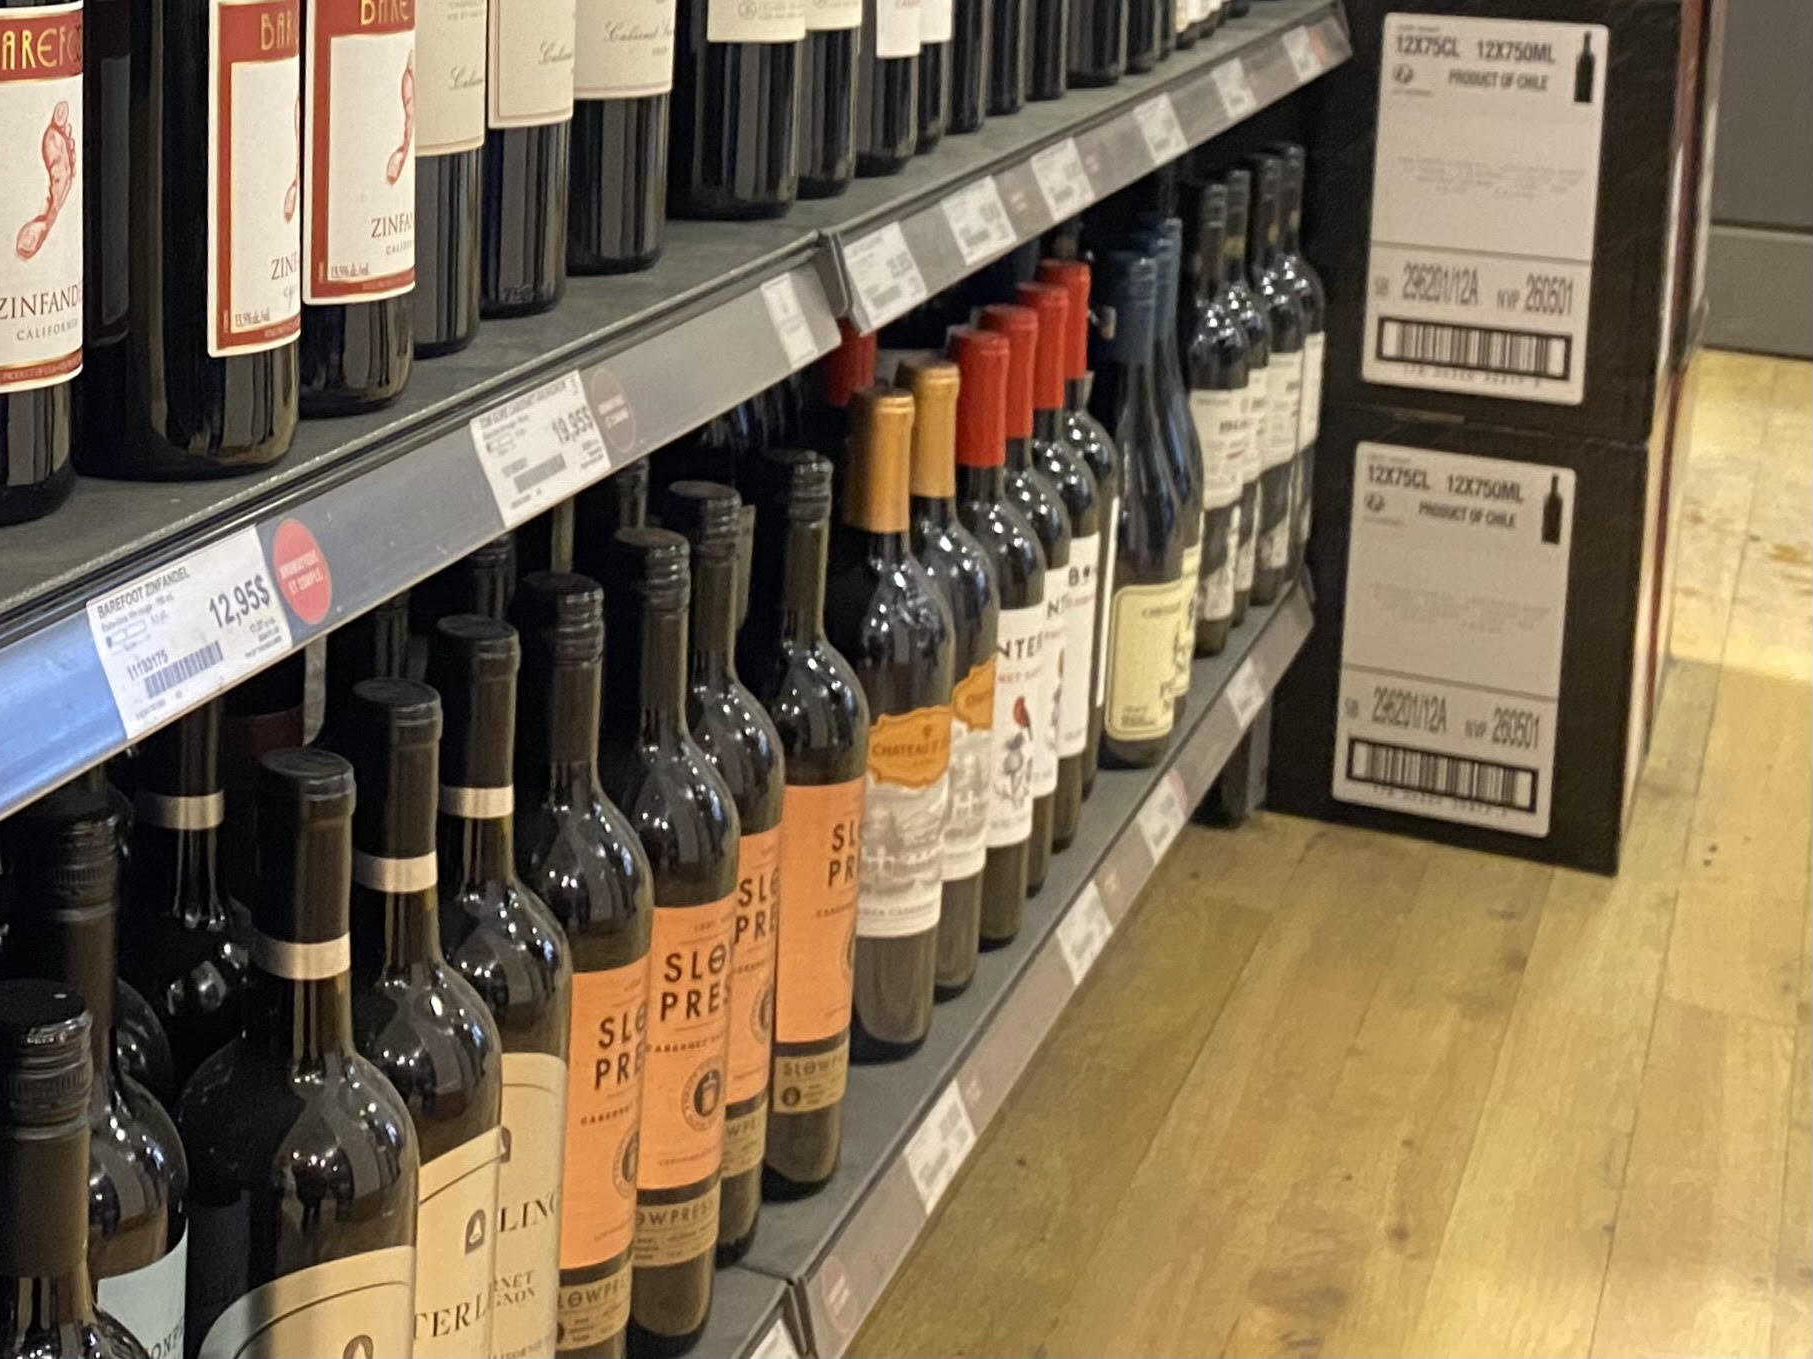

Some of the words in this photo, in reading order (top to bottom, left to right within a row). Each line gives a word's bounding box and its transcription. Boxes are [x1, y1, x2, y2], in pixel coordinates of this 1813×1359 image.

[1396, 36, 1460, 59] 12X75CL
[1477, 41, 1556, 65] 12X750ML
[1448, 69, 1499, 88] PRODUCT
[1500, 72, 1515, 89] OF
[1517, 74, 1549, 92] CHILE
[1524, 273, 1574, 315] 260501
[1366, 463, 1431, 490] 12X75CL
[1447, 474, 1525, 505] 12X750ML
[1418, 501, 1468, 523] PRODUCT
[1469, 507, 1483, 524] OF
[1485, 510, 1517, 529] CHILE
[97, 586, 144, 620] BAREFOOT
[144, 566, 191, 597] ZINFANDEL
